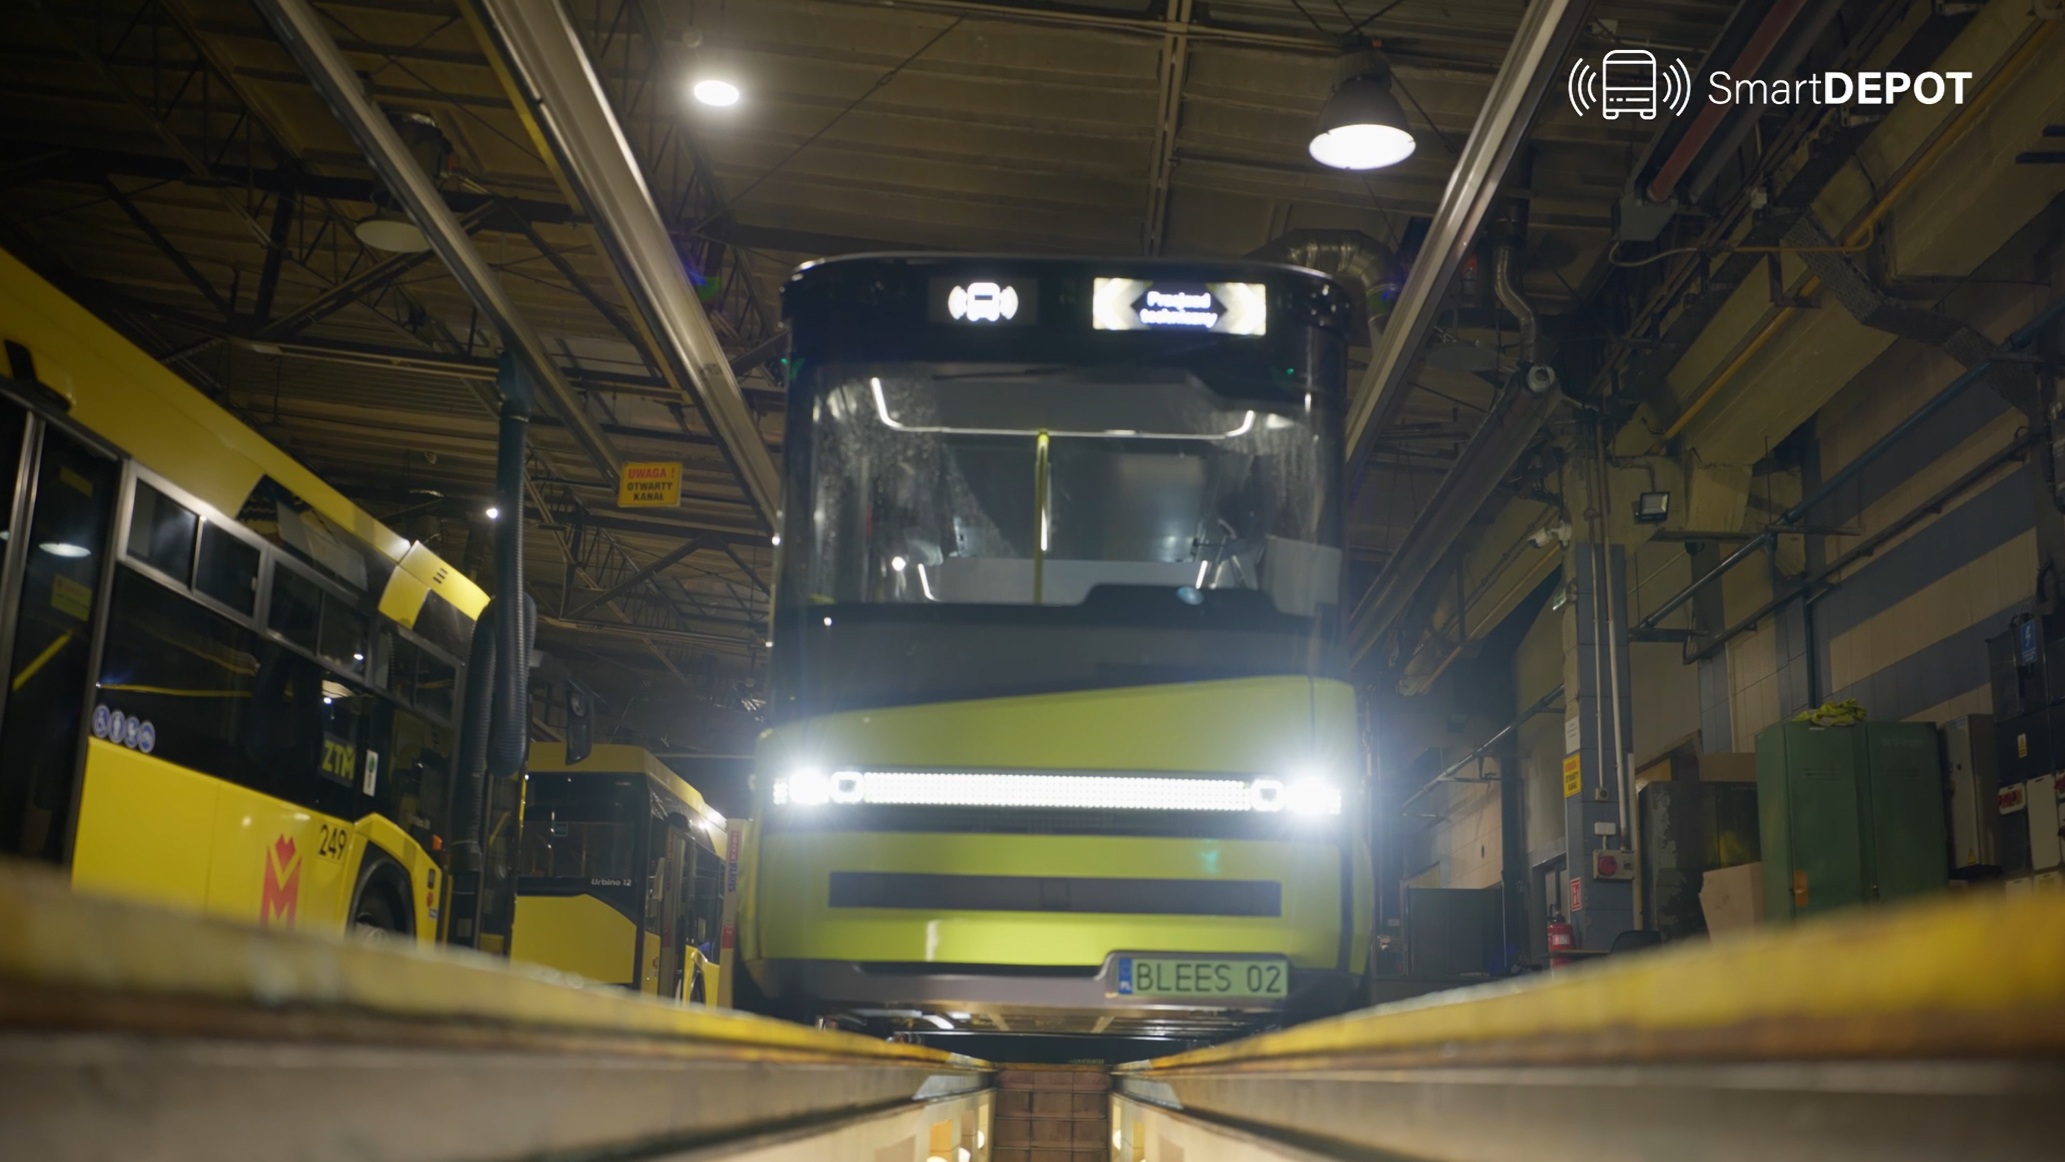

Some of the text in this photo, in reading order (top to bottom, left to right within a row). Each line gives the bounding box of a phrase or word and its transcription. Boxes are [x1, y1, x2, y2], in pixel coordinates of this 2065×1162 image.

[628, 468, 667, 479] UWAGA
[627, 482, 672, 492] OTWARTY
[323, 740, 357, 780] ZTM
[319, 824, 347, 860] 249
[591, 878, 621, 886] Urbino
[1136, 962, 1281, 993] BLEES 02
